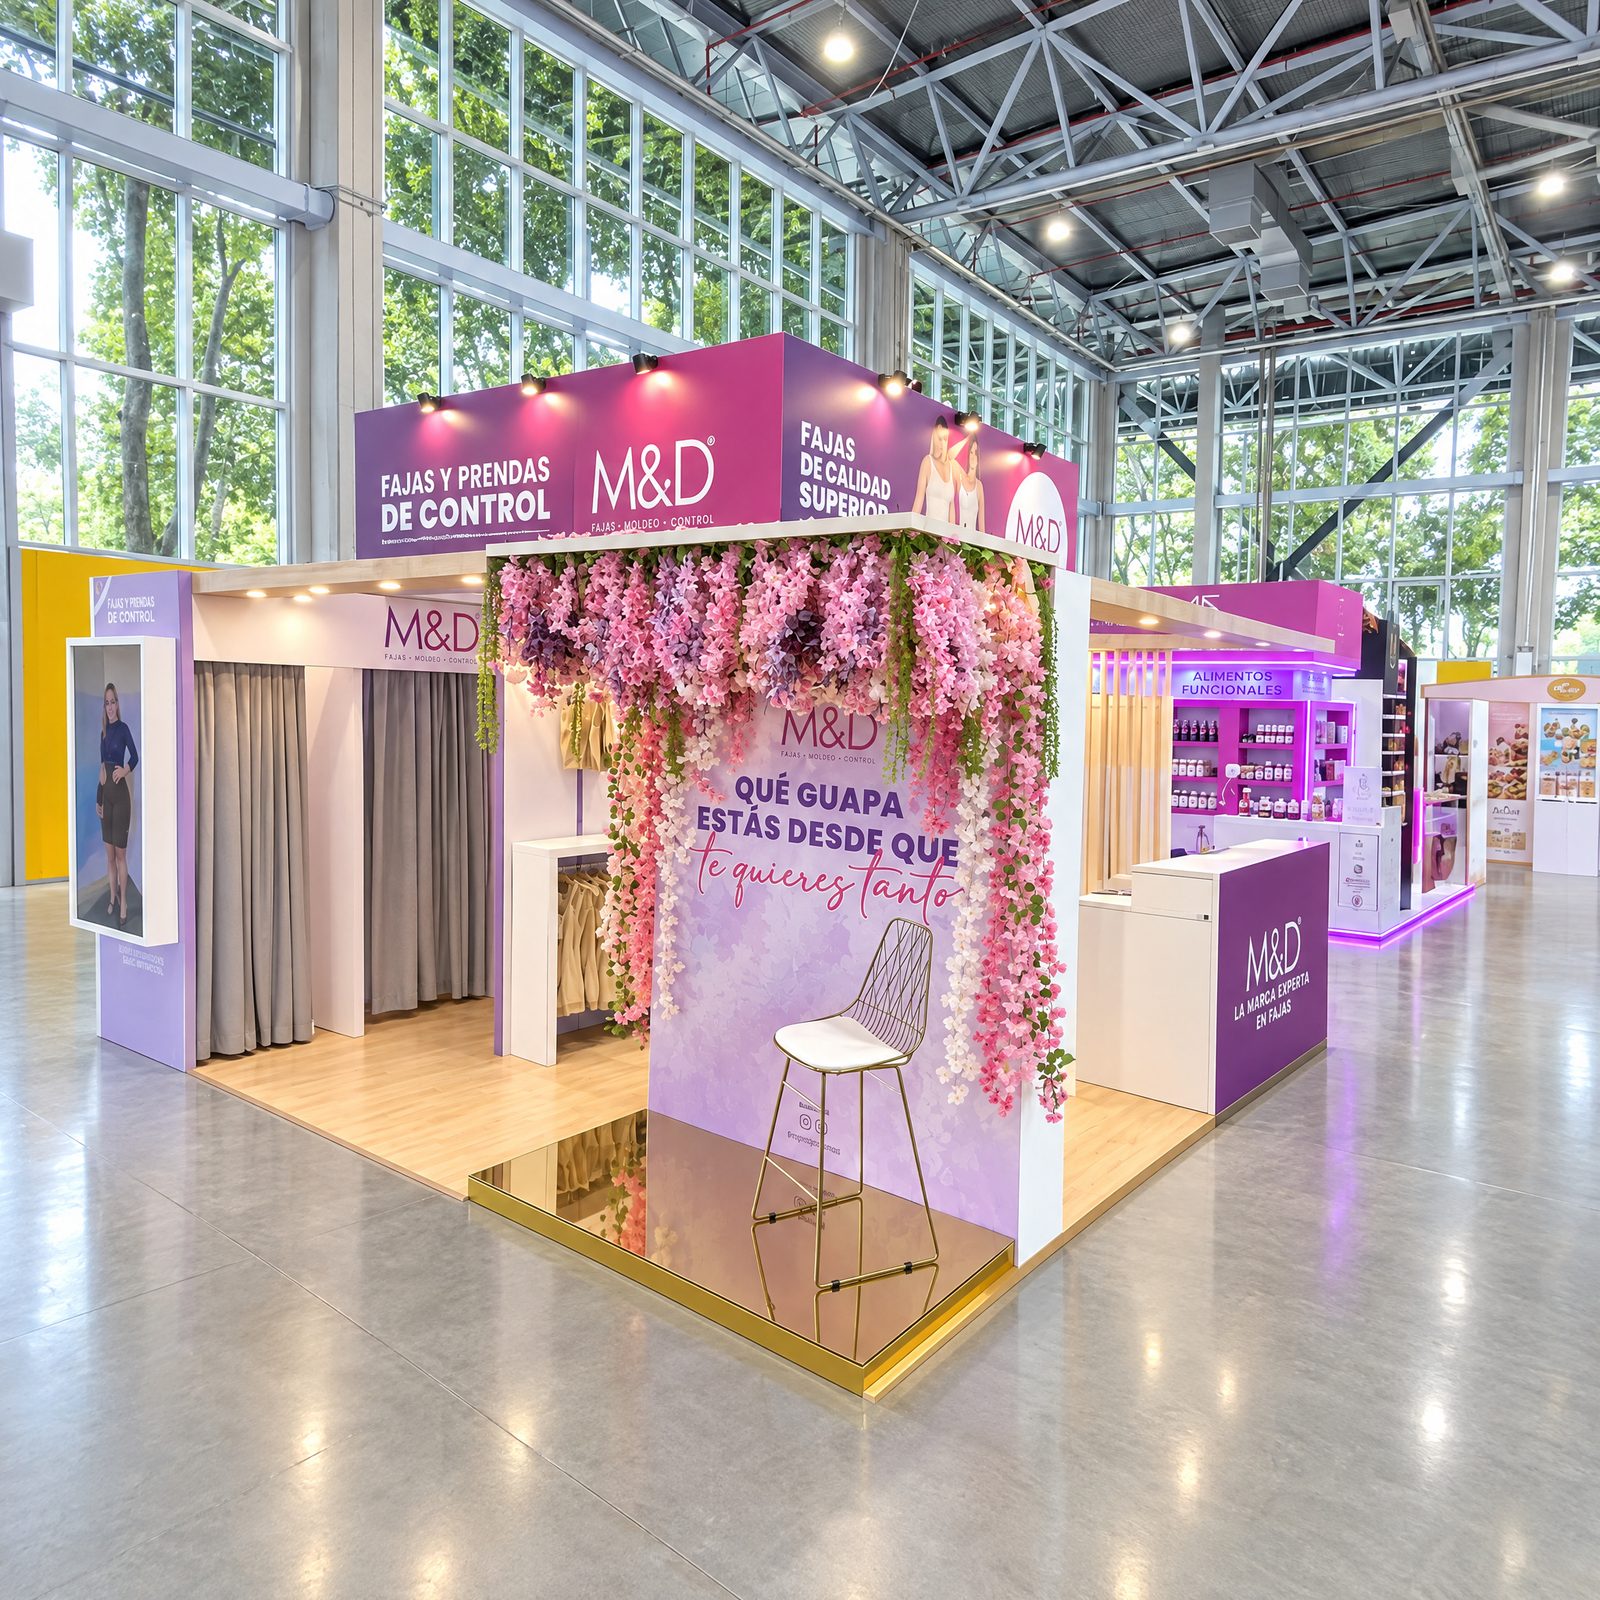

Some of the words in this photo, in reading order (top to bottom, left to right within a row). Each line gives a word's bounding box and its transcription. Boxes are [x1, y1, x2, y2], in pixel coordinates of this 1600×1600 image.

[801, 420, 855, 462] FAJAS
[381, 469, 435, 498] FAJAS
[439, 467, 452, 492] Y
[458, 455, 550, 490] PRENDAS
[800, 451, 823, 481] DE
[825, 460, 891, 501] CALIDAD
[381, 501, 413, 533] DE
[419, 488, 551, 530] CONTROL
[591, 521, 616, 533] FAJAS
[624, 518, 660, 531] MOLDEO
[670, 514, 714, 528] CONTROL
[107, 598, 123, 609] FAJAS
[124, 597, 130, 609] Y
[129, 596, 155, 608] PRENDAS
[107, 611, 118, 624] DE
[119, 609, 155, 622] CONTROL
[384, 653, 407, 661] FAJAS
[414, 655, 441, 663] MOLDEO
[448, 657, 478, 665] CONTROL
[1192, 671, 1273, 682] ALIMENTOS
[1181, 684, 1282, 696] FUNCIONALES
[781, 706, 878, 751] M&D
[780, 750, 801, 758] FAJAS
[808, 753, 836, 761] MOLDEO
[843, 755, 877, 765] CONTROL
[735, 771, 790, 805] QUÉ
[796, 782, 904, 819] GUAPA
[697, 804, 781, 841] ESTÁS
[788, 818, 883, 855] DESDE
[891, 832, 959, 868] QUE
[689, 832, 733, 895] te
[731, 860, 855, 911] quieres
[848, 849, 966, 926] tanto
[1234, 1003, 1245, 1021] LA
[1247, 989, 1276, 1014] MARCA
[1278, 971, 1310, 999] EXPERTA
[1256, 1013, 1267, 1030] EN
[1268, 999, 1292, 1024] FAJAS
